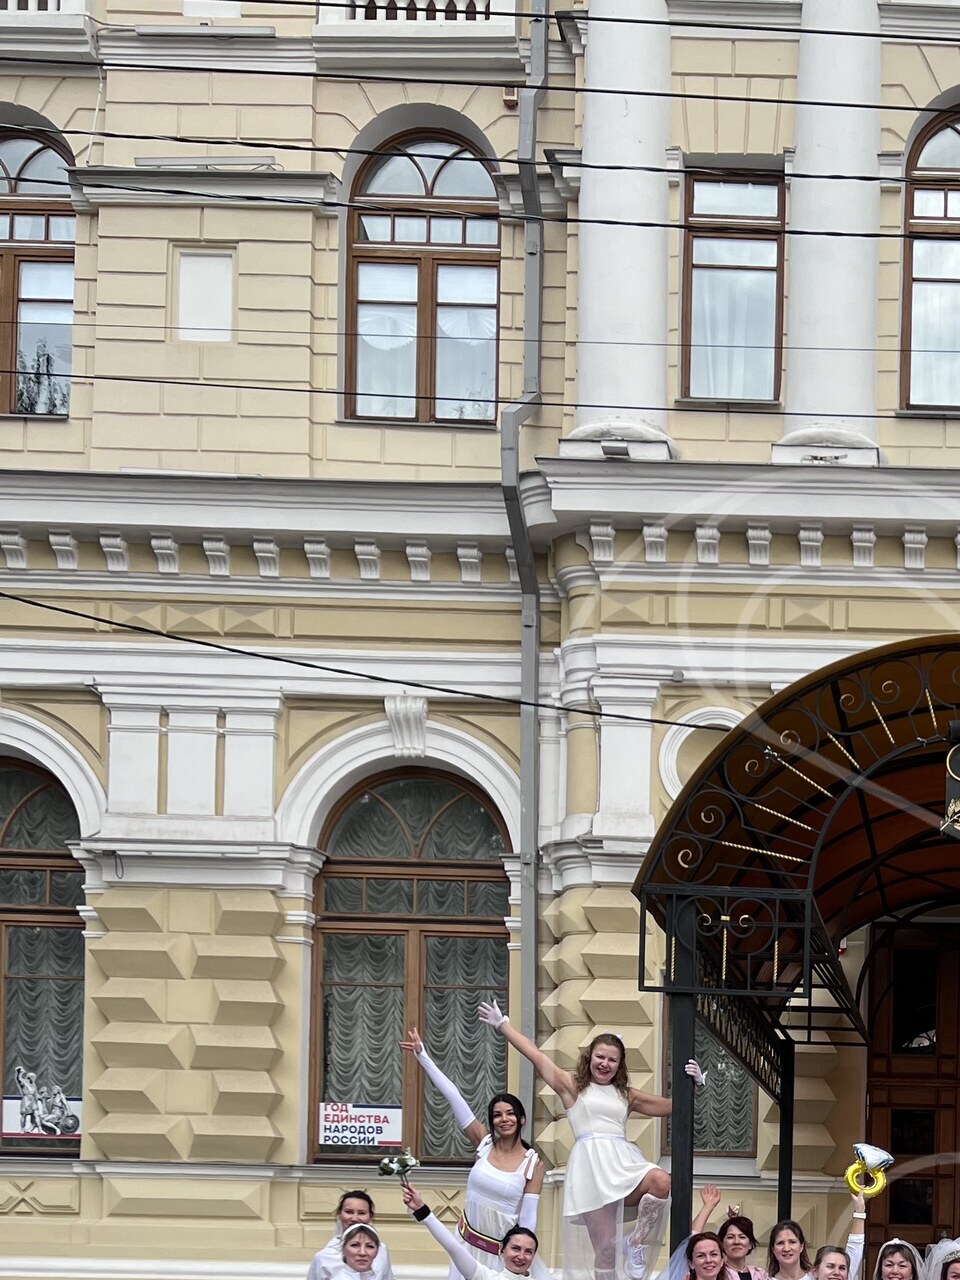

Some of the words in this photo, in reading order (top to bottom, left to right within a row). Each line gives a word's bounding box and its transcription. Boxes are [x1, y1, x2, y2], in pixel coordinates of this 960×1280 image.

[324, 1103, 348, 1113] ГОД
[324, 1114, 390, 1124] ЕДИНСТВА
[323, 1125, 383, 1136] НАРОДОВ
[323, 1135, 375, 1145] РОССИИ
